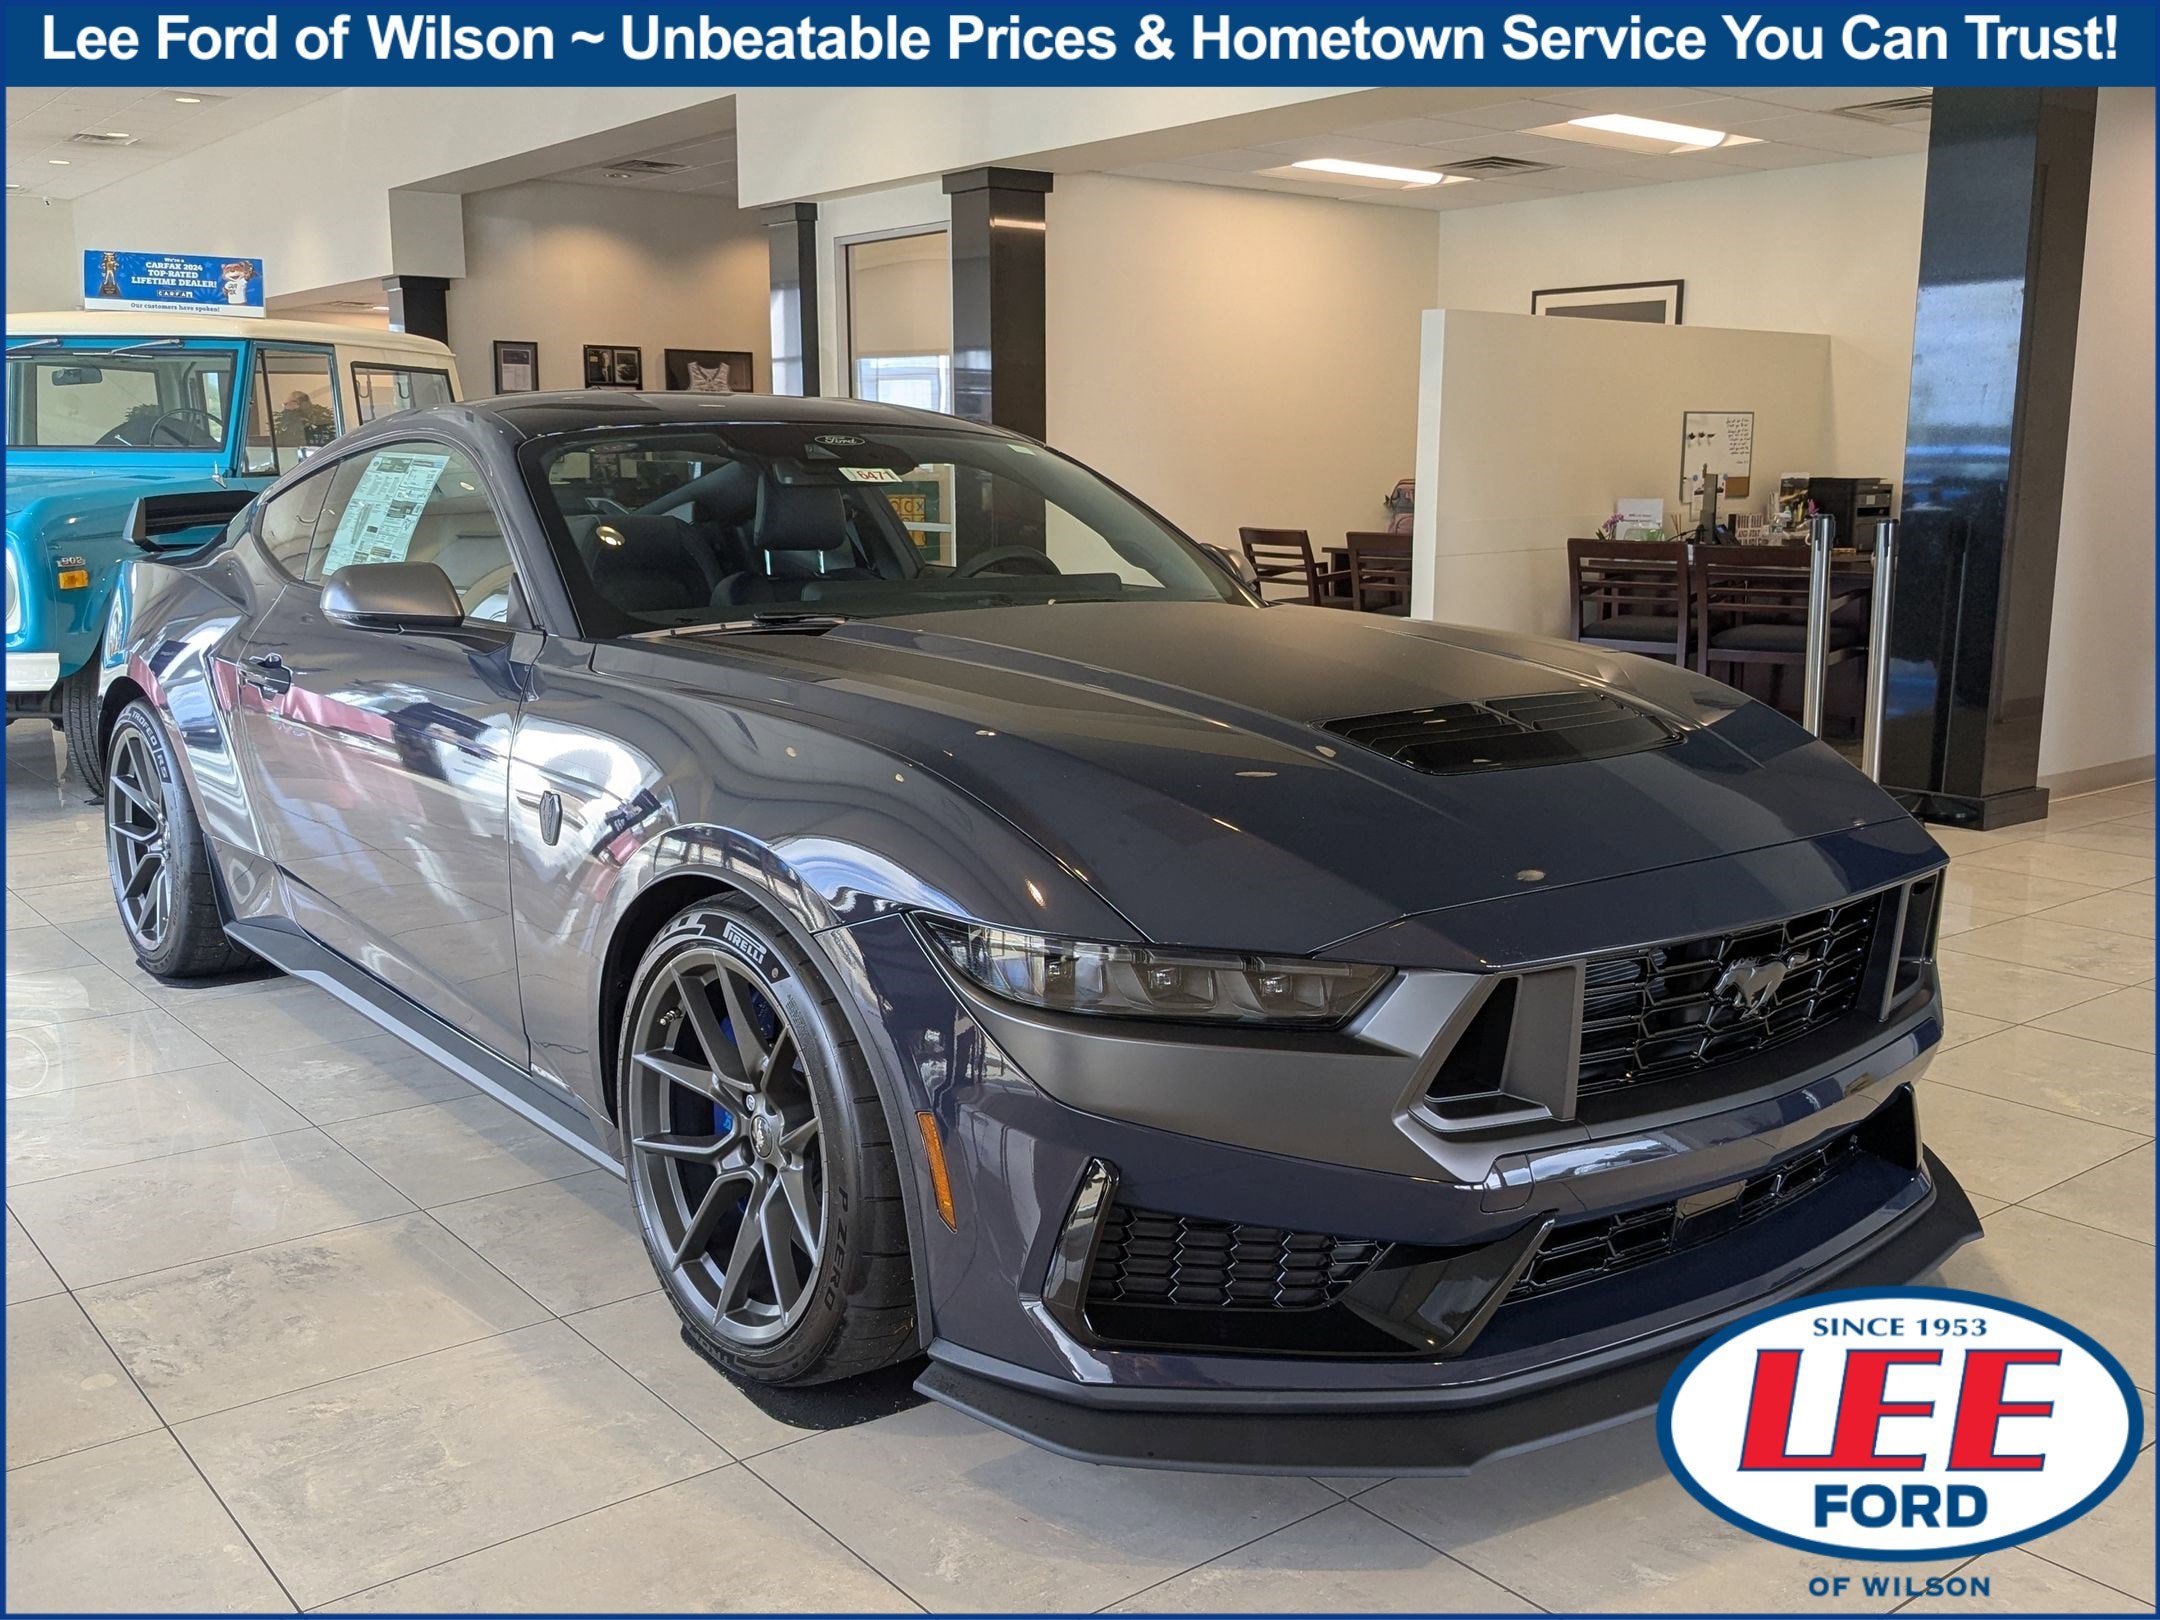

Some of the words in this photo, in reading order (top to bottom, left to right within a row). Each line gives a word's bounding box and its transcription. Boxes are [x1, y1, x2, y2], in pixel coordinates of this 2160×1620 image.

[145, 262, 181, 270] CARFAX
[183, 263, 203, 271] 2024
[148, 269, 199, 279] TOP-RATED
[131, 276, 177, 286] LIFETIME
[178, 279, 218, 288] DEALER!
[195, 305, 220, 313] spoken!
[825, 436, 857, 445] Ford
[857, 470, 897, 480] 6471
[132, 710, 158, 747] TROFEO
[157, 754, 169, 779] RS
[722, 921, 768, 965] PIRELLI
[838, 1186, 849, 1213] P
[824, 1217, 848, 1312] ZERO
